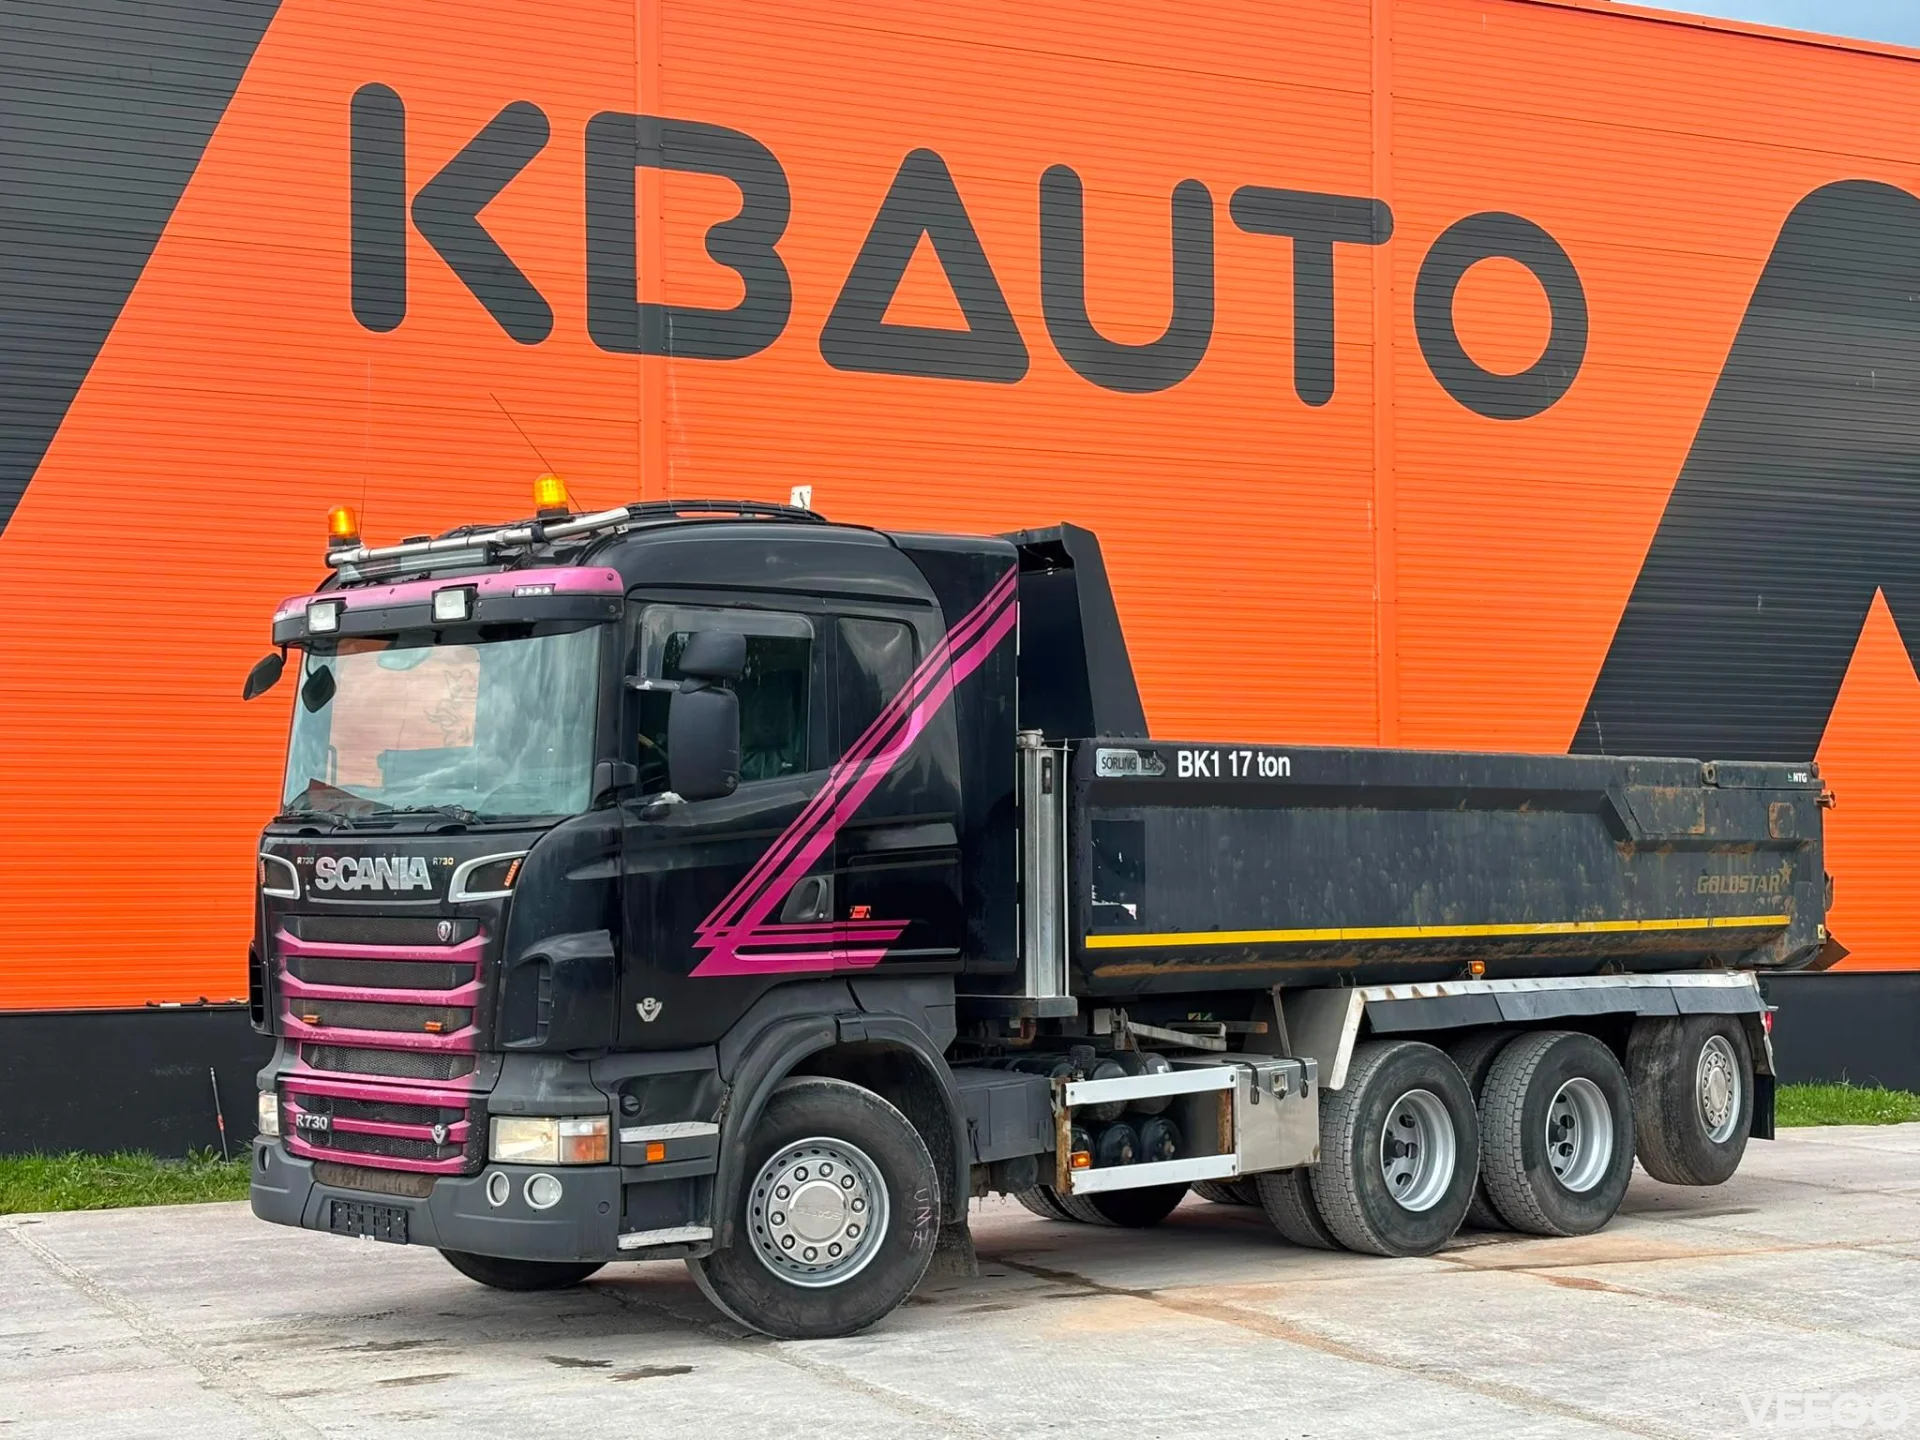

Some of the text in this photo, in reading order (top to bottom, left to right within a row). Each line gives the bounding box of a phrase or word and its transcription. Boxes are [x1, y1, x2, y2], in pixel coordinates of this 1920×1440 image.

[1177, 750, 1291, 777] BK1 17 ton
[1793, 772, 1808, 783] NTG
[296, 856, 314, 865] R730
[432, 856, 455, 866] R730
[314, 856, 433, 891] SCANIA
[1697, 873, 1780, 894] GOLDSTAR
[295, 1113, 328, 1130] R730
